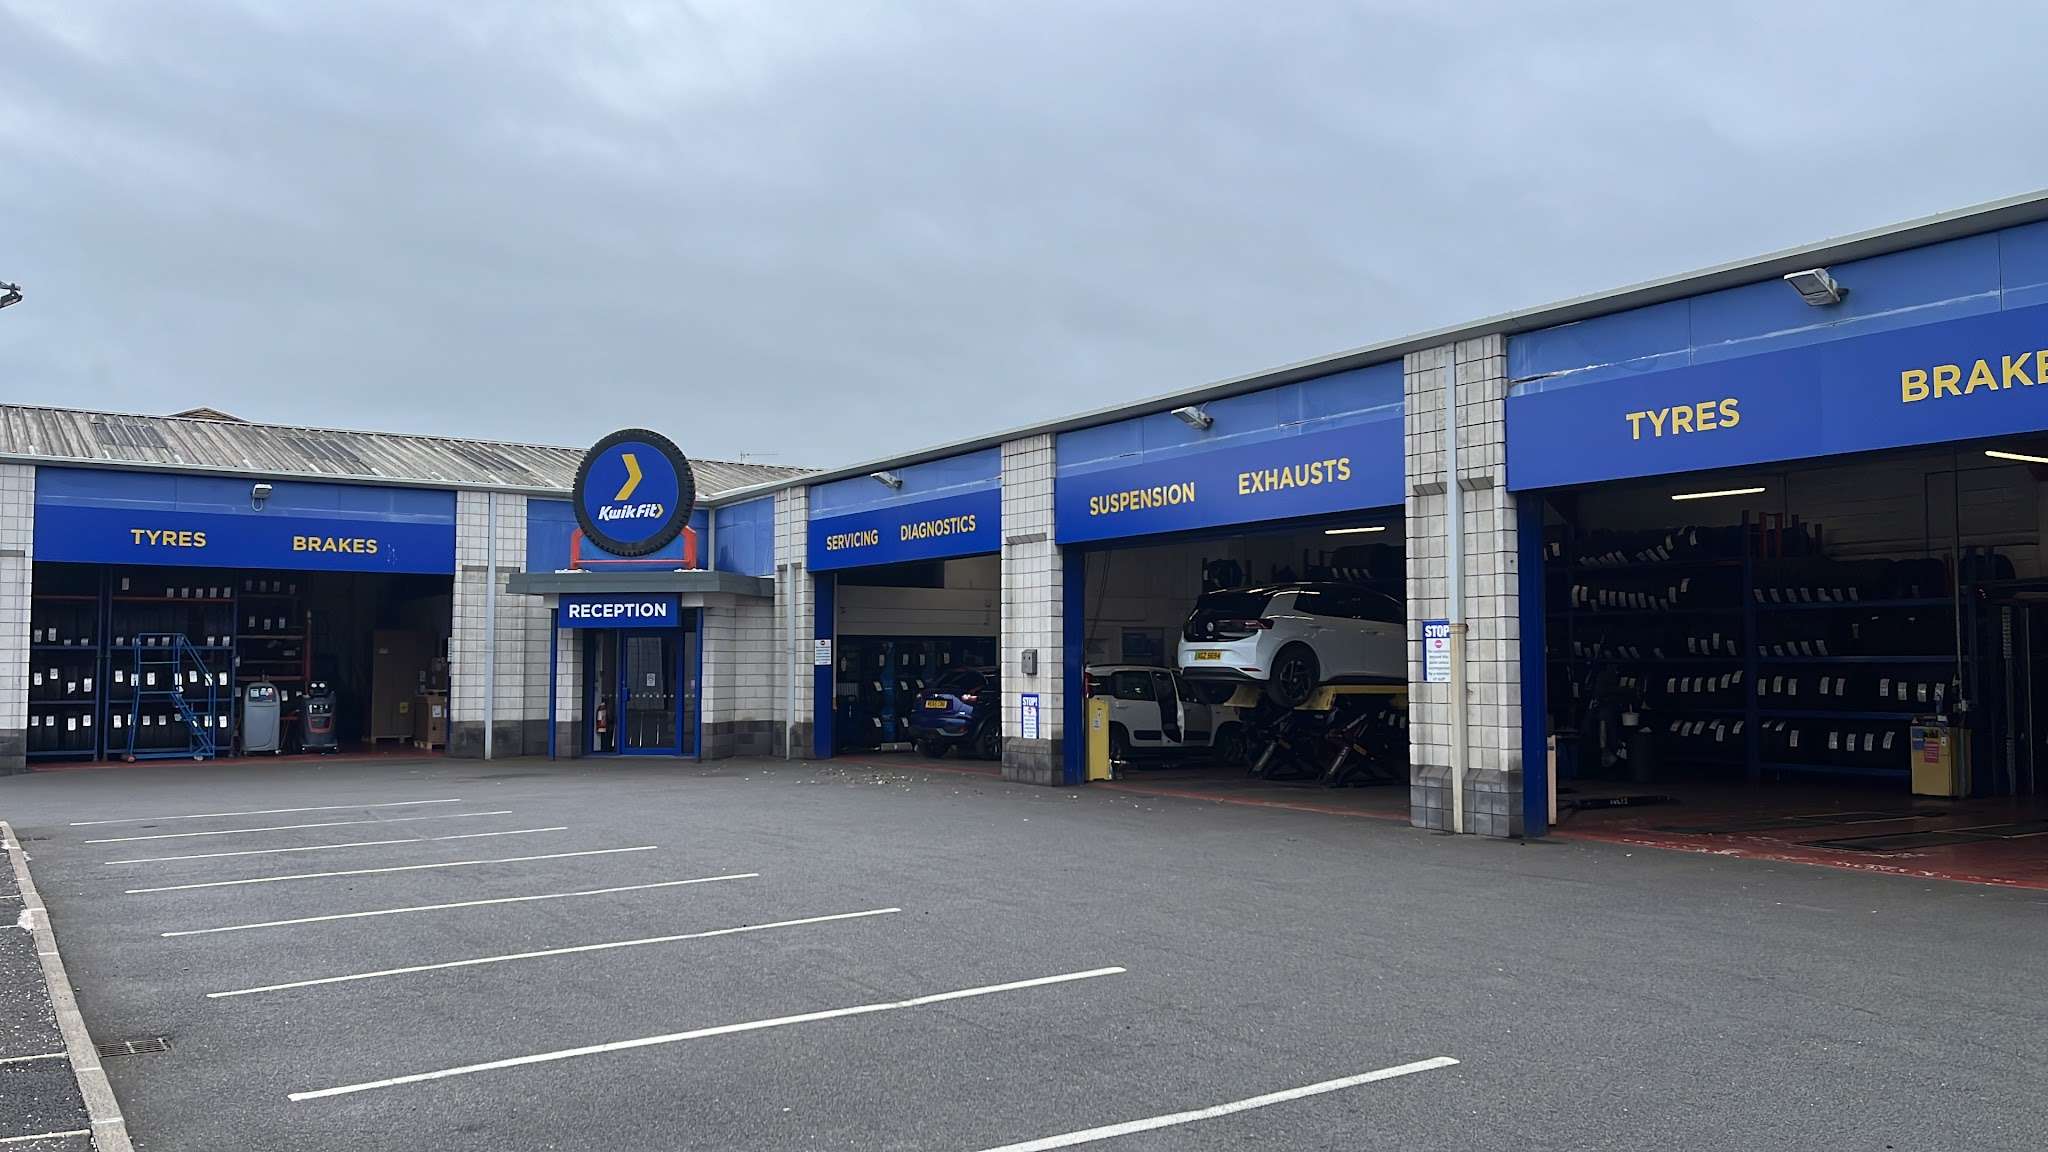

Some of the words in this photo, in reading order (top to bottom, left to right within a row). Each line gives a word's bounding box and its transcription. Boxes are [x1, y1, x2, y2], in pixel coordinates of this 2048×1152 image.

[1626, 398, 1740, 441] TYRES
[1089, 482, 1195, 516] SUSPENSION
[1238, 457, 1351, 495] EXHAUSTS
[130, 529, 206, 547] TYRES
[292, 535, 378, 554] BRAKES
[826, 529, 879, 551] SERVICING
[900, 514, 976, 541] DIAGNOSTICS
[568, 603, 667, 618] RECEPTION
[1424, 625, 1450, 637] STOP
